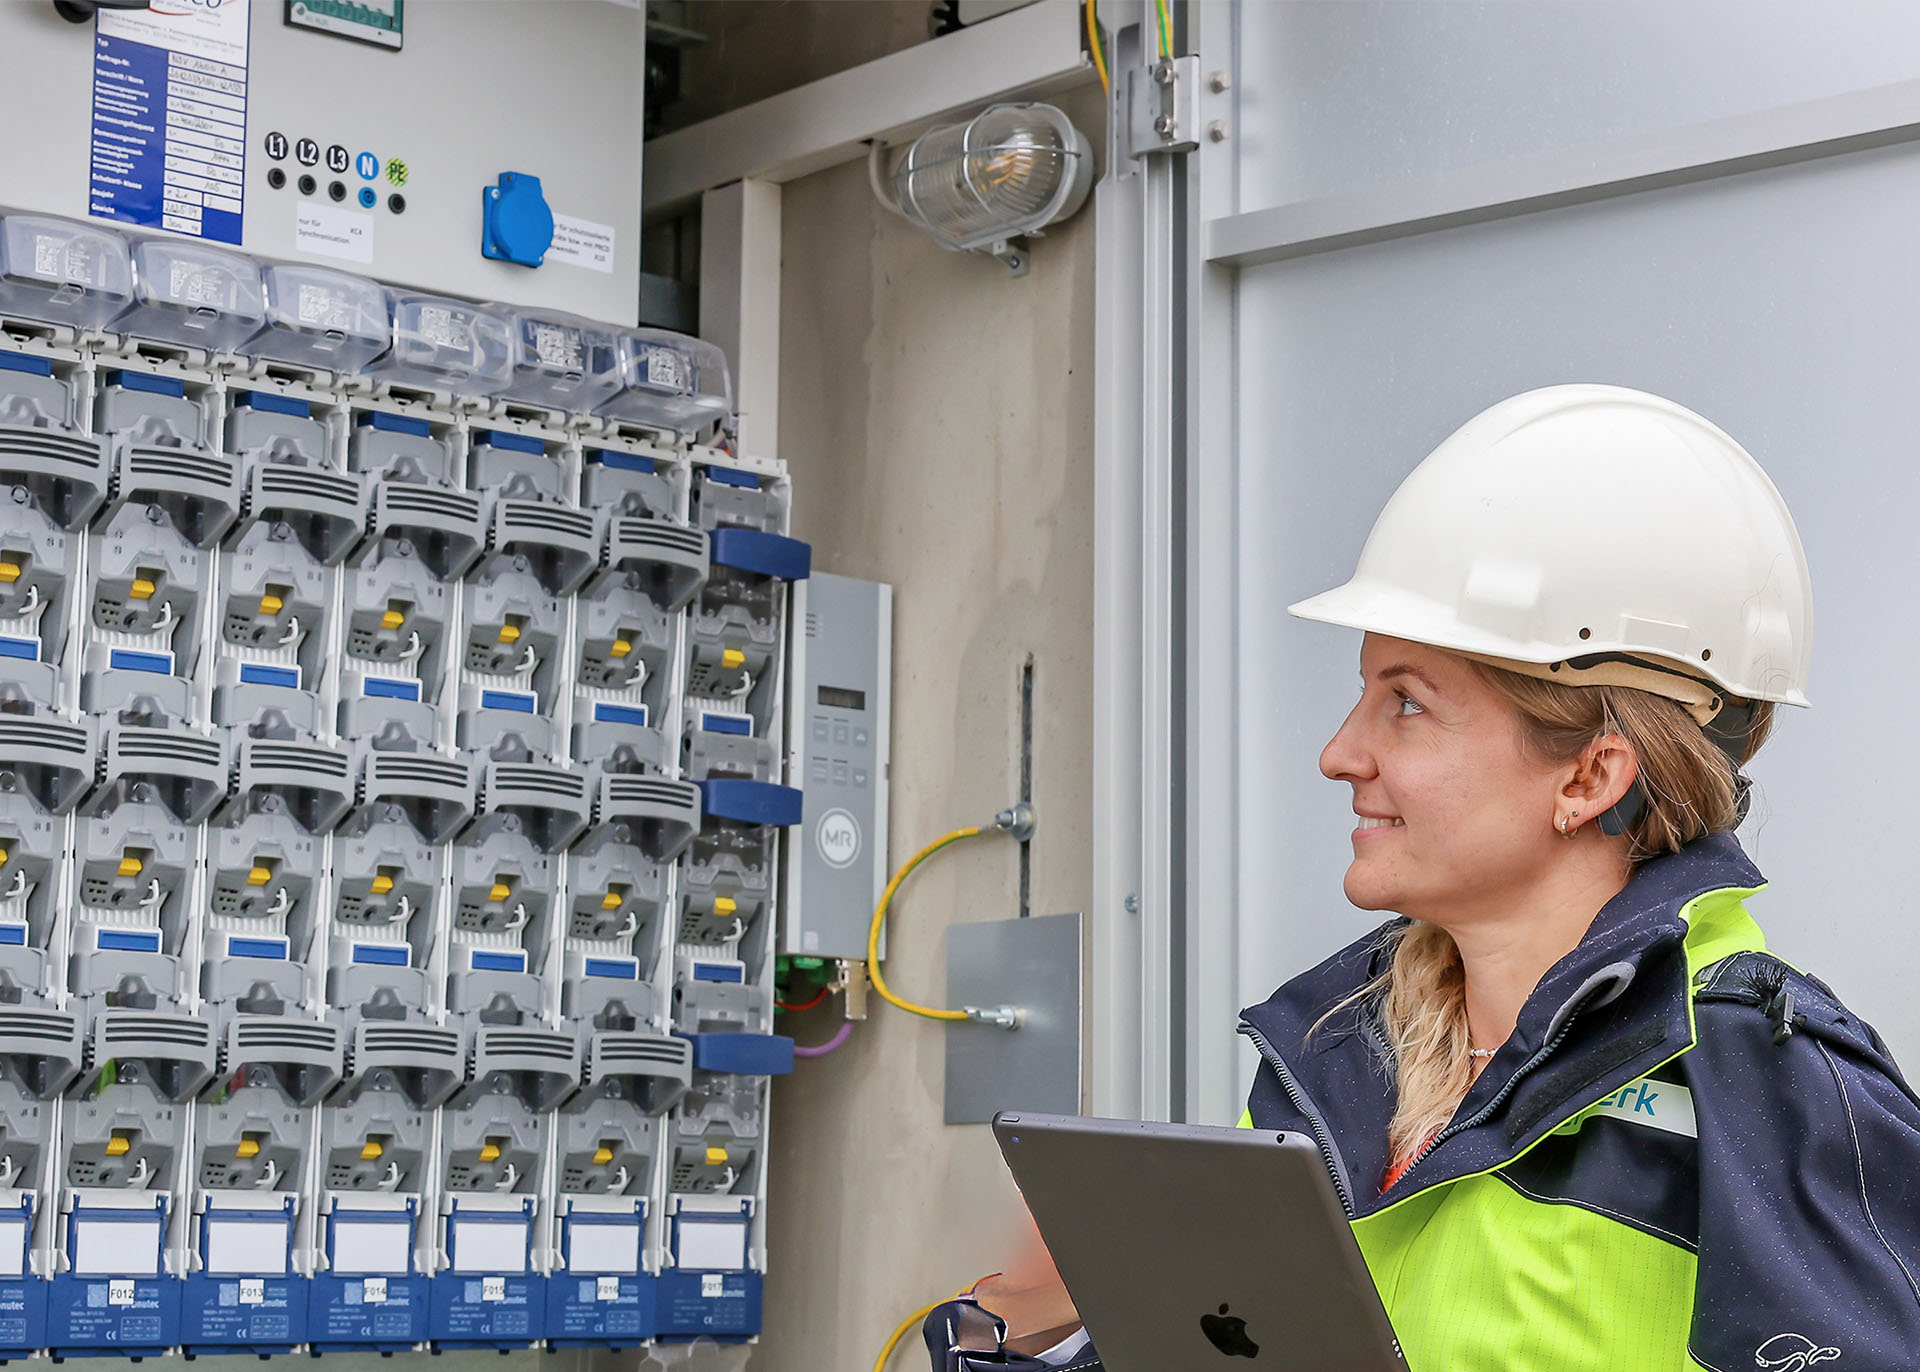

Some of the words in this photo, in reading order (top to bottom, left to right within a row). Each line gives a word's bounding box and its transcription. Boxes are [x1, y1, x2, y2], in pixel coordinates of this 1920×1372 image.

[269, 135, 285, 158] L1
[299, 141, 317, 164] L2
[329, 148, 347, 171] L3
[361, 155, 374, 177] N
[390, 162, 406, 182] PE
[825, 829, 851, 848] MR
[110, 1288, 135, 1299] F012
[241, 1287, 264, 1297] F013
[364, 1286, 387, 1296] F014
[483, 1285, 505, 1295] F015
